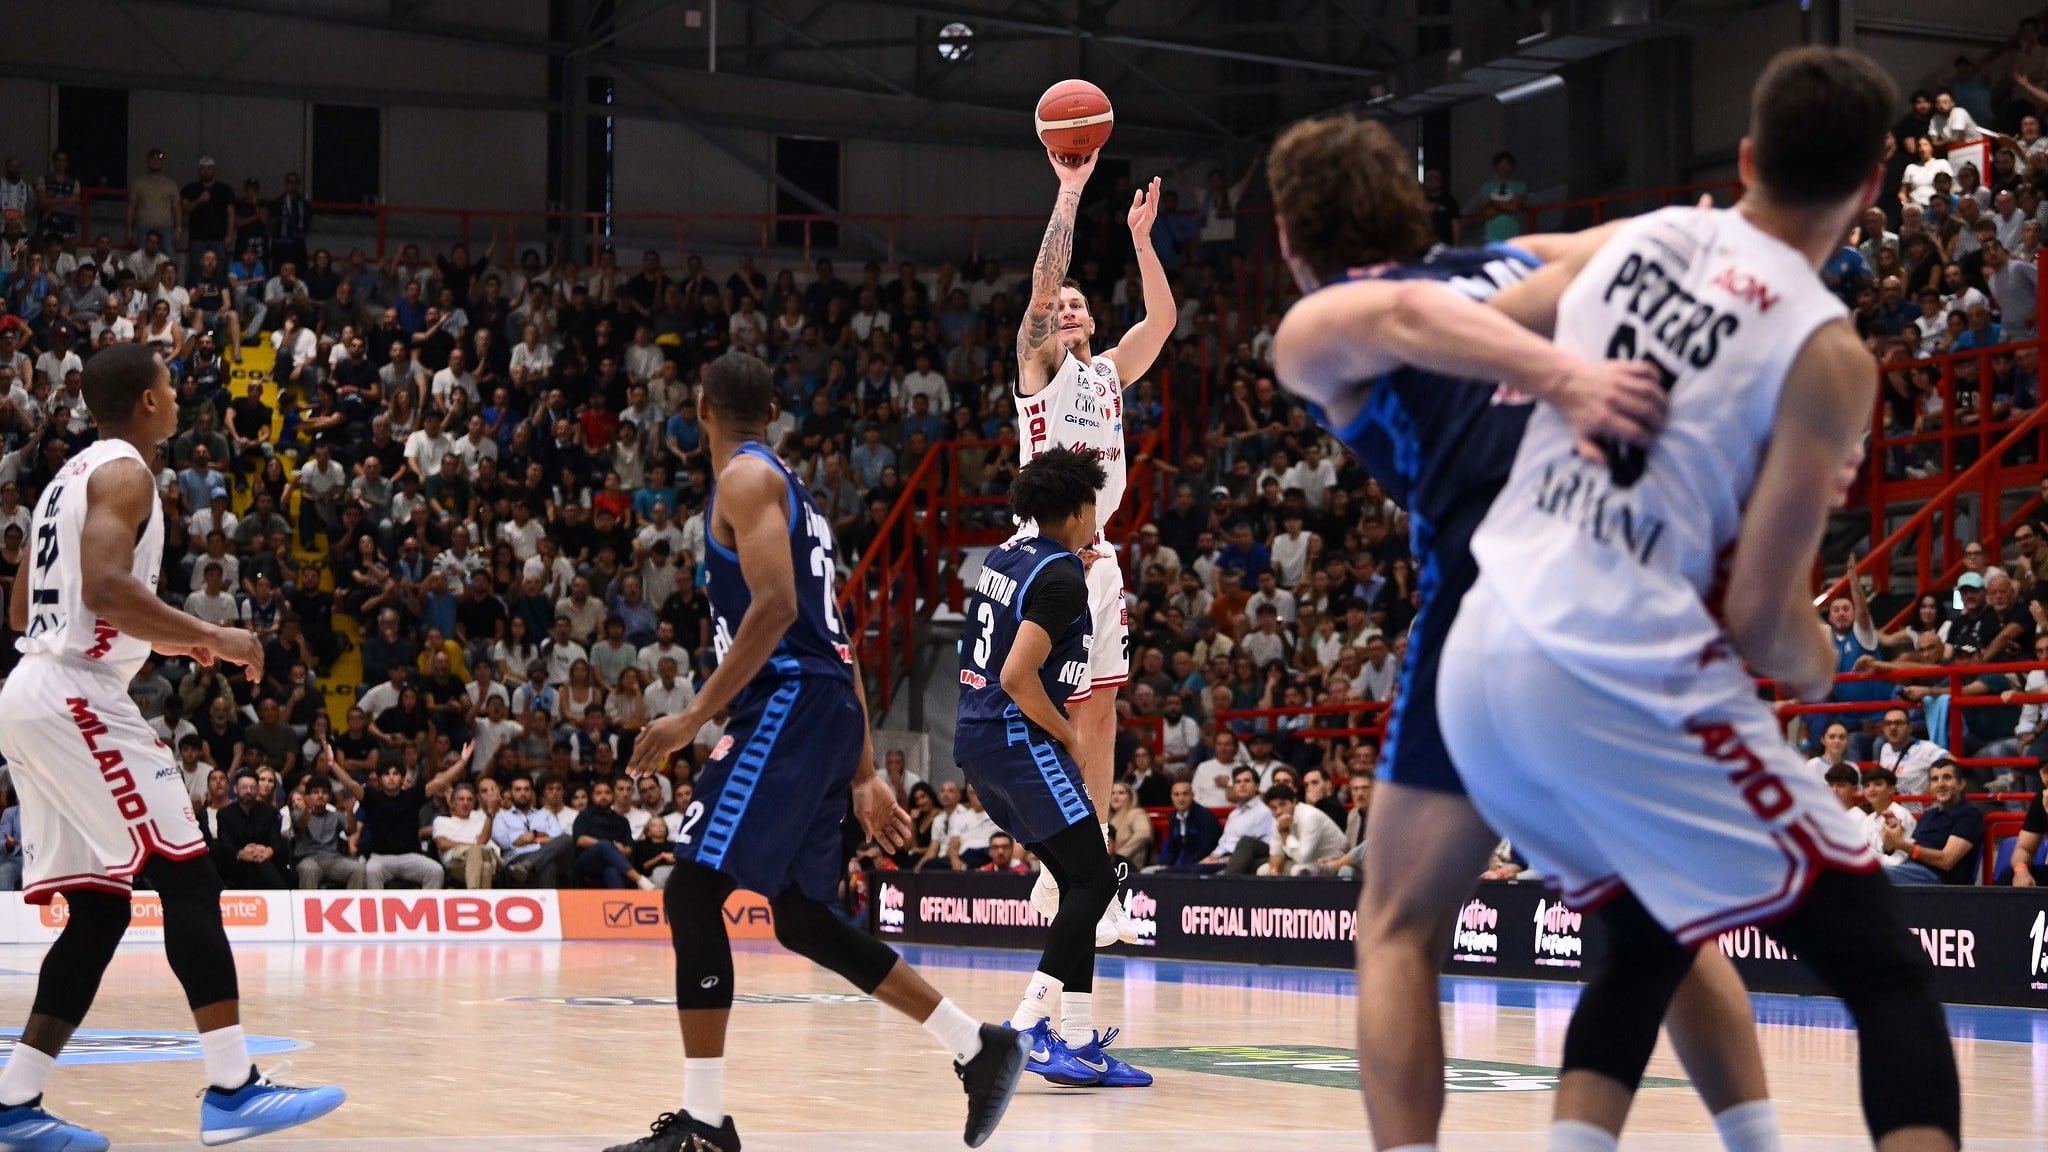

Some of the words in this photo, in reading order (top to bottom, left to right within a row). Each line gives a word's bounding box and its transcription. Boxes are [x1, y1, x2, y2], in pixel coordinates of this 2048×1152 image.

[1604, 253, 1739, 370] PETERS
[972, 602, 995, 670] 3
[66, 697, 148, 821] MILANO
[677, 800, 704, 844] 2
[304, 896, 544, 934] KIMBO
[919, 896, 972, 924] OFFICIAL
[972, 897, 1038, 926] NUTRITION
[1181, 905, 1248, 937] OFFICIAL
[1250, 908, 1336, 940] NUTRITION
